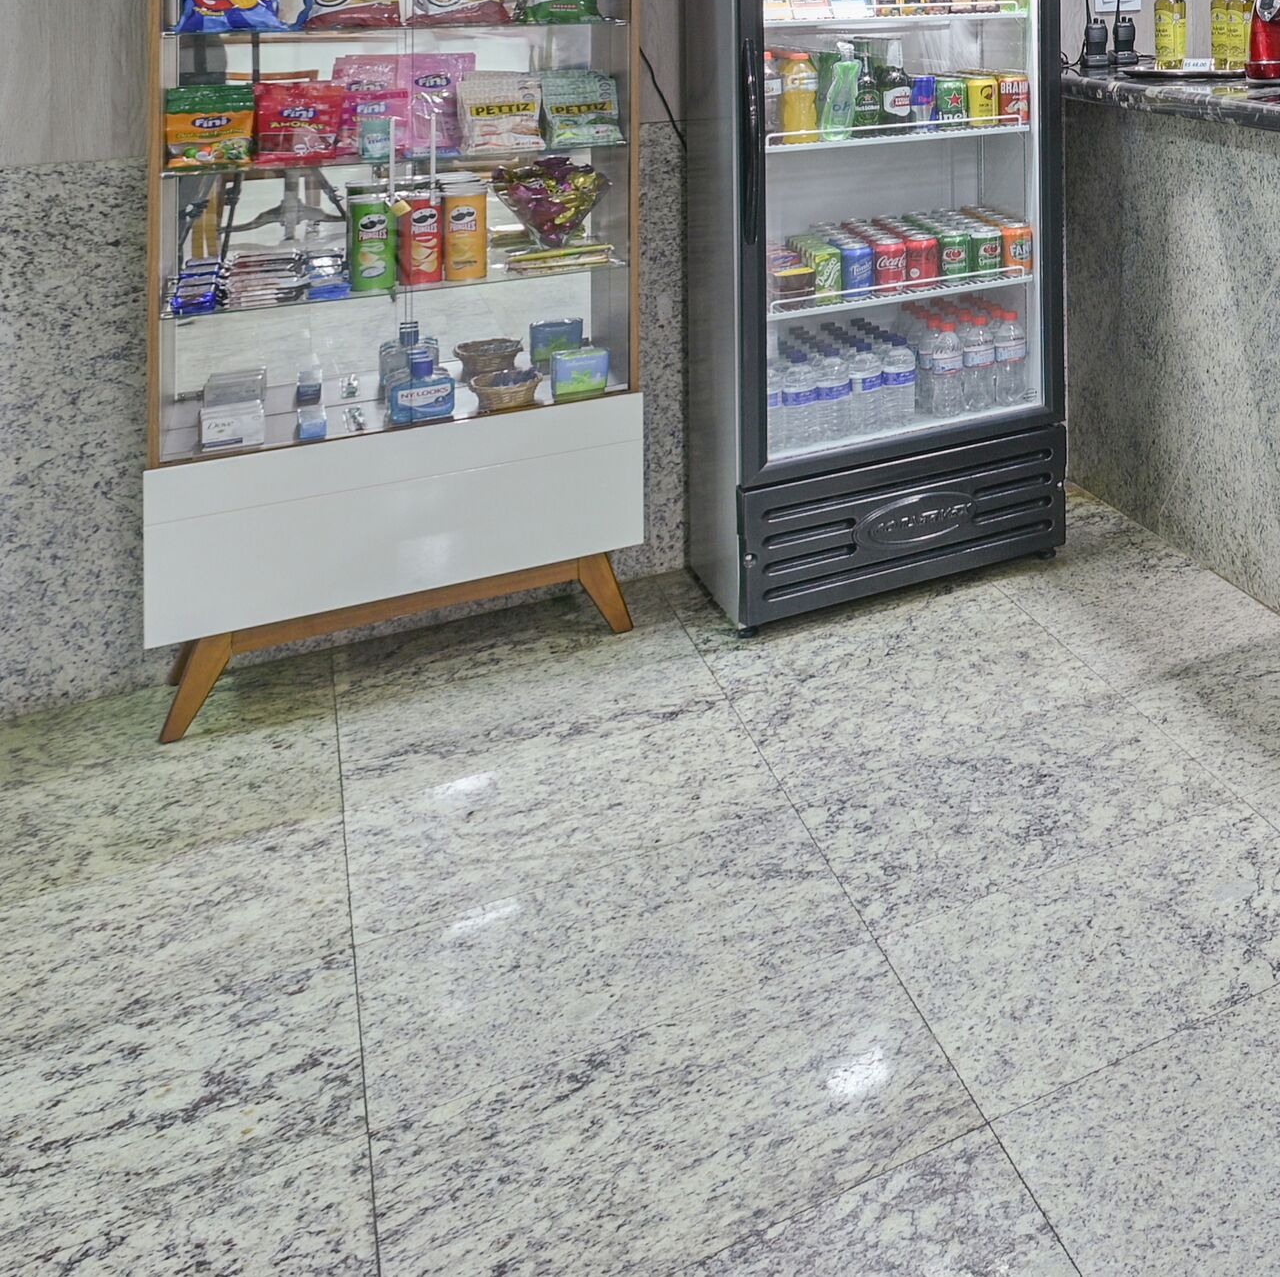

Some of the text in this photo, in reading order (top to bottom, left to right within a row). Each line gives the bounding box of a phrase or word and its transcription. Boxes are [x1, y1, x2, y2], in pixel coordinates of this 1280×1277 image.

[281, 108, 315, 119] Fini
[475, 103, 532, 116] PETTIZ
[554, 102, 608, 115] PETTIZ
[194, 116, 228, 128] Fini
